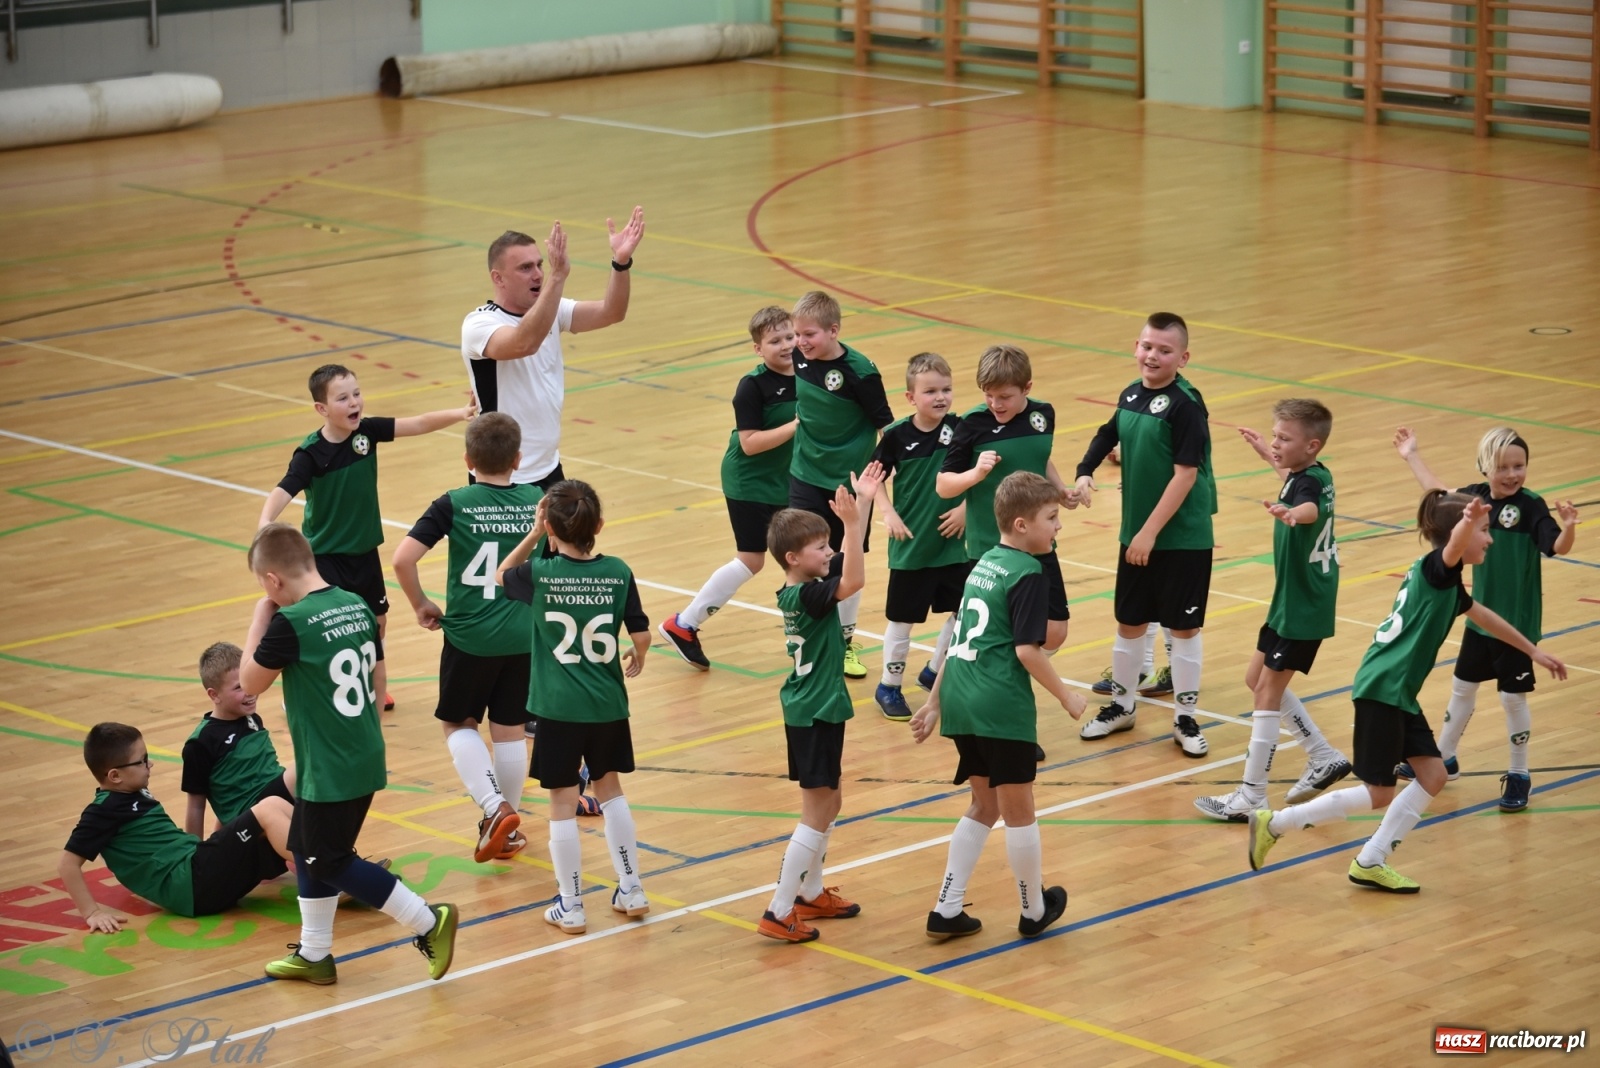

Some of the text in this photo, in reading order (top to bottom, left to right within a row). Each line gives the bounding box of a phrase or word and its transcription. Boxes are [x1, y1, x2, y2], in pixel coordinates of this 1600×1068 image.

[462, 506, 503, 514] AKADEMIA
[539, 576, 624, 585] AKADEMIA PIŁKARSKA
[550, 585, 590, 593] MŁODEGO
[544, 592, 615, 605] TWORKÓW
[544, 611, 617, 664] 26
